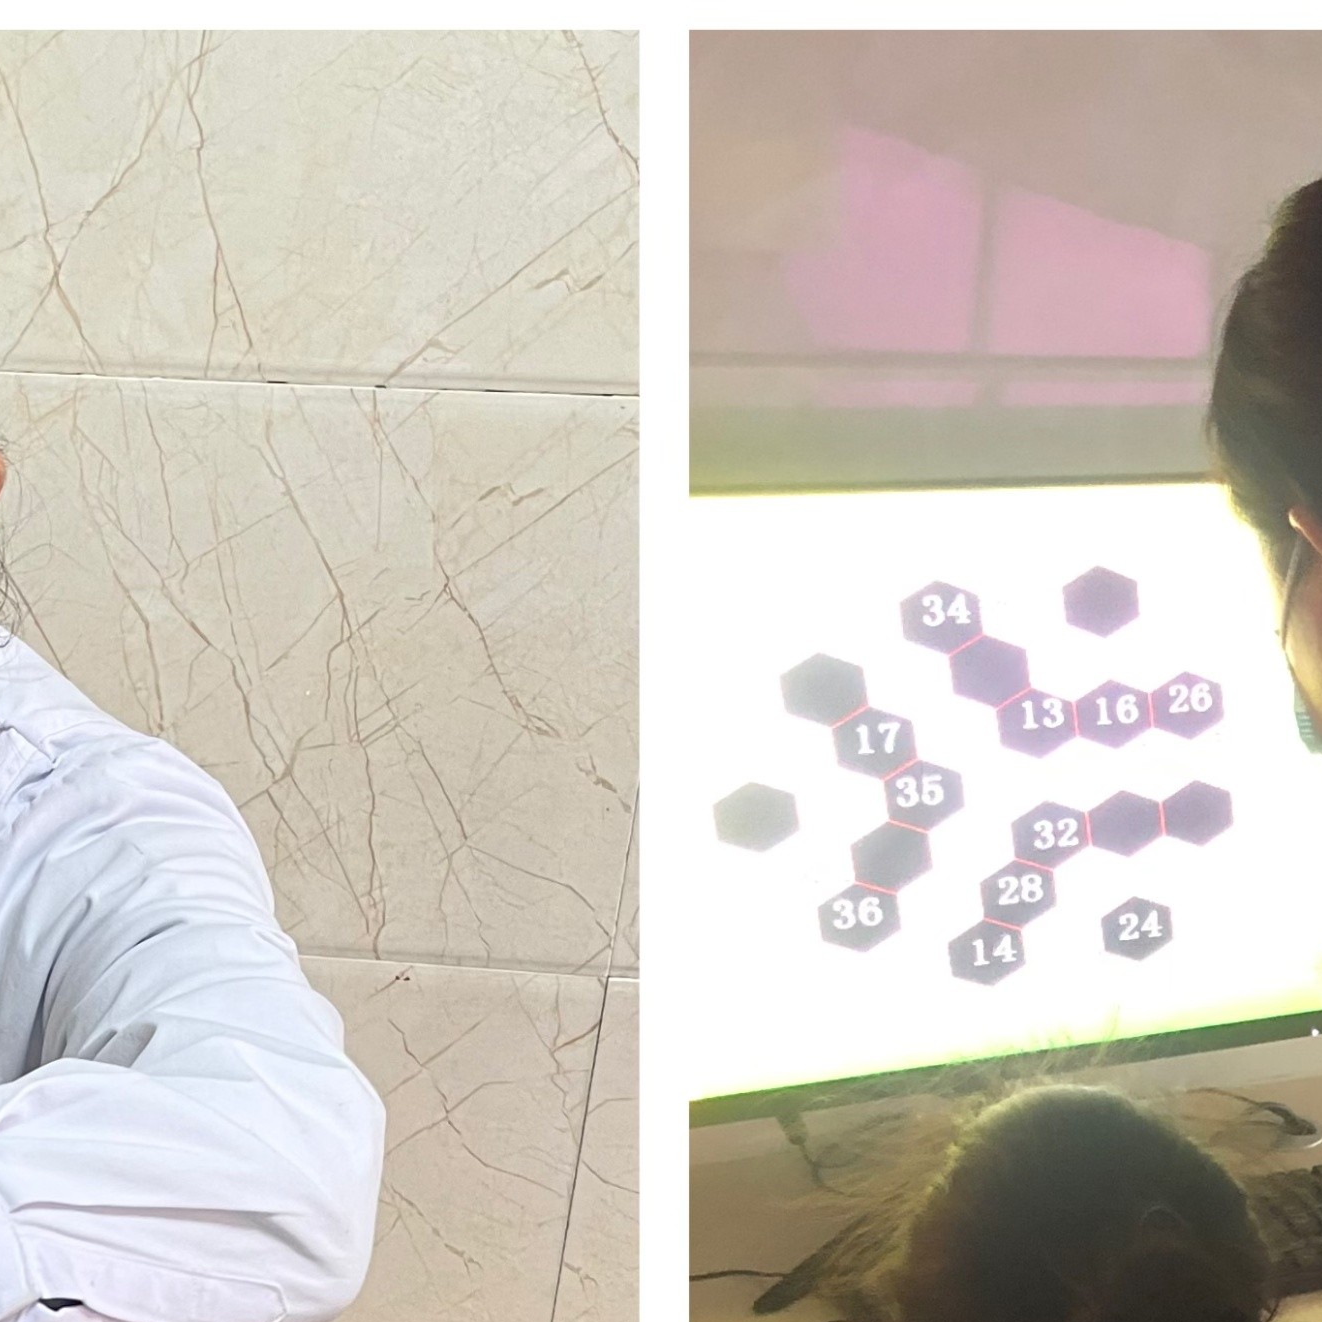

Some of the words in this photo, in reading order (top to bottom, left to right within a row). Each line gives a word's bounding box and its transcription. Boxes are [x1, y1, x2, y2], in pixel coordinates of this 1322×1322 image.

[921, 592, 972, 627] 34
[1021, 694, 1066, 730] 13
[1095, 693, 1140, 726] 16
[1168, 682, 1213, 714] 26
[855, 720, 901, 755] 17
[895, 773, 945, 808] 35
[1033, 819, 1080, 851] 32
[997, 874, 1044, 906] 28
[832, 895, 884, 930] 36
[1118, 909, 1163, 941] 24
[972, 935, 1017, 967] 14
